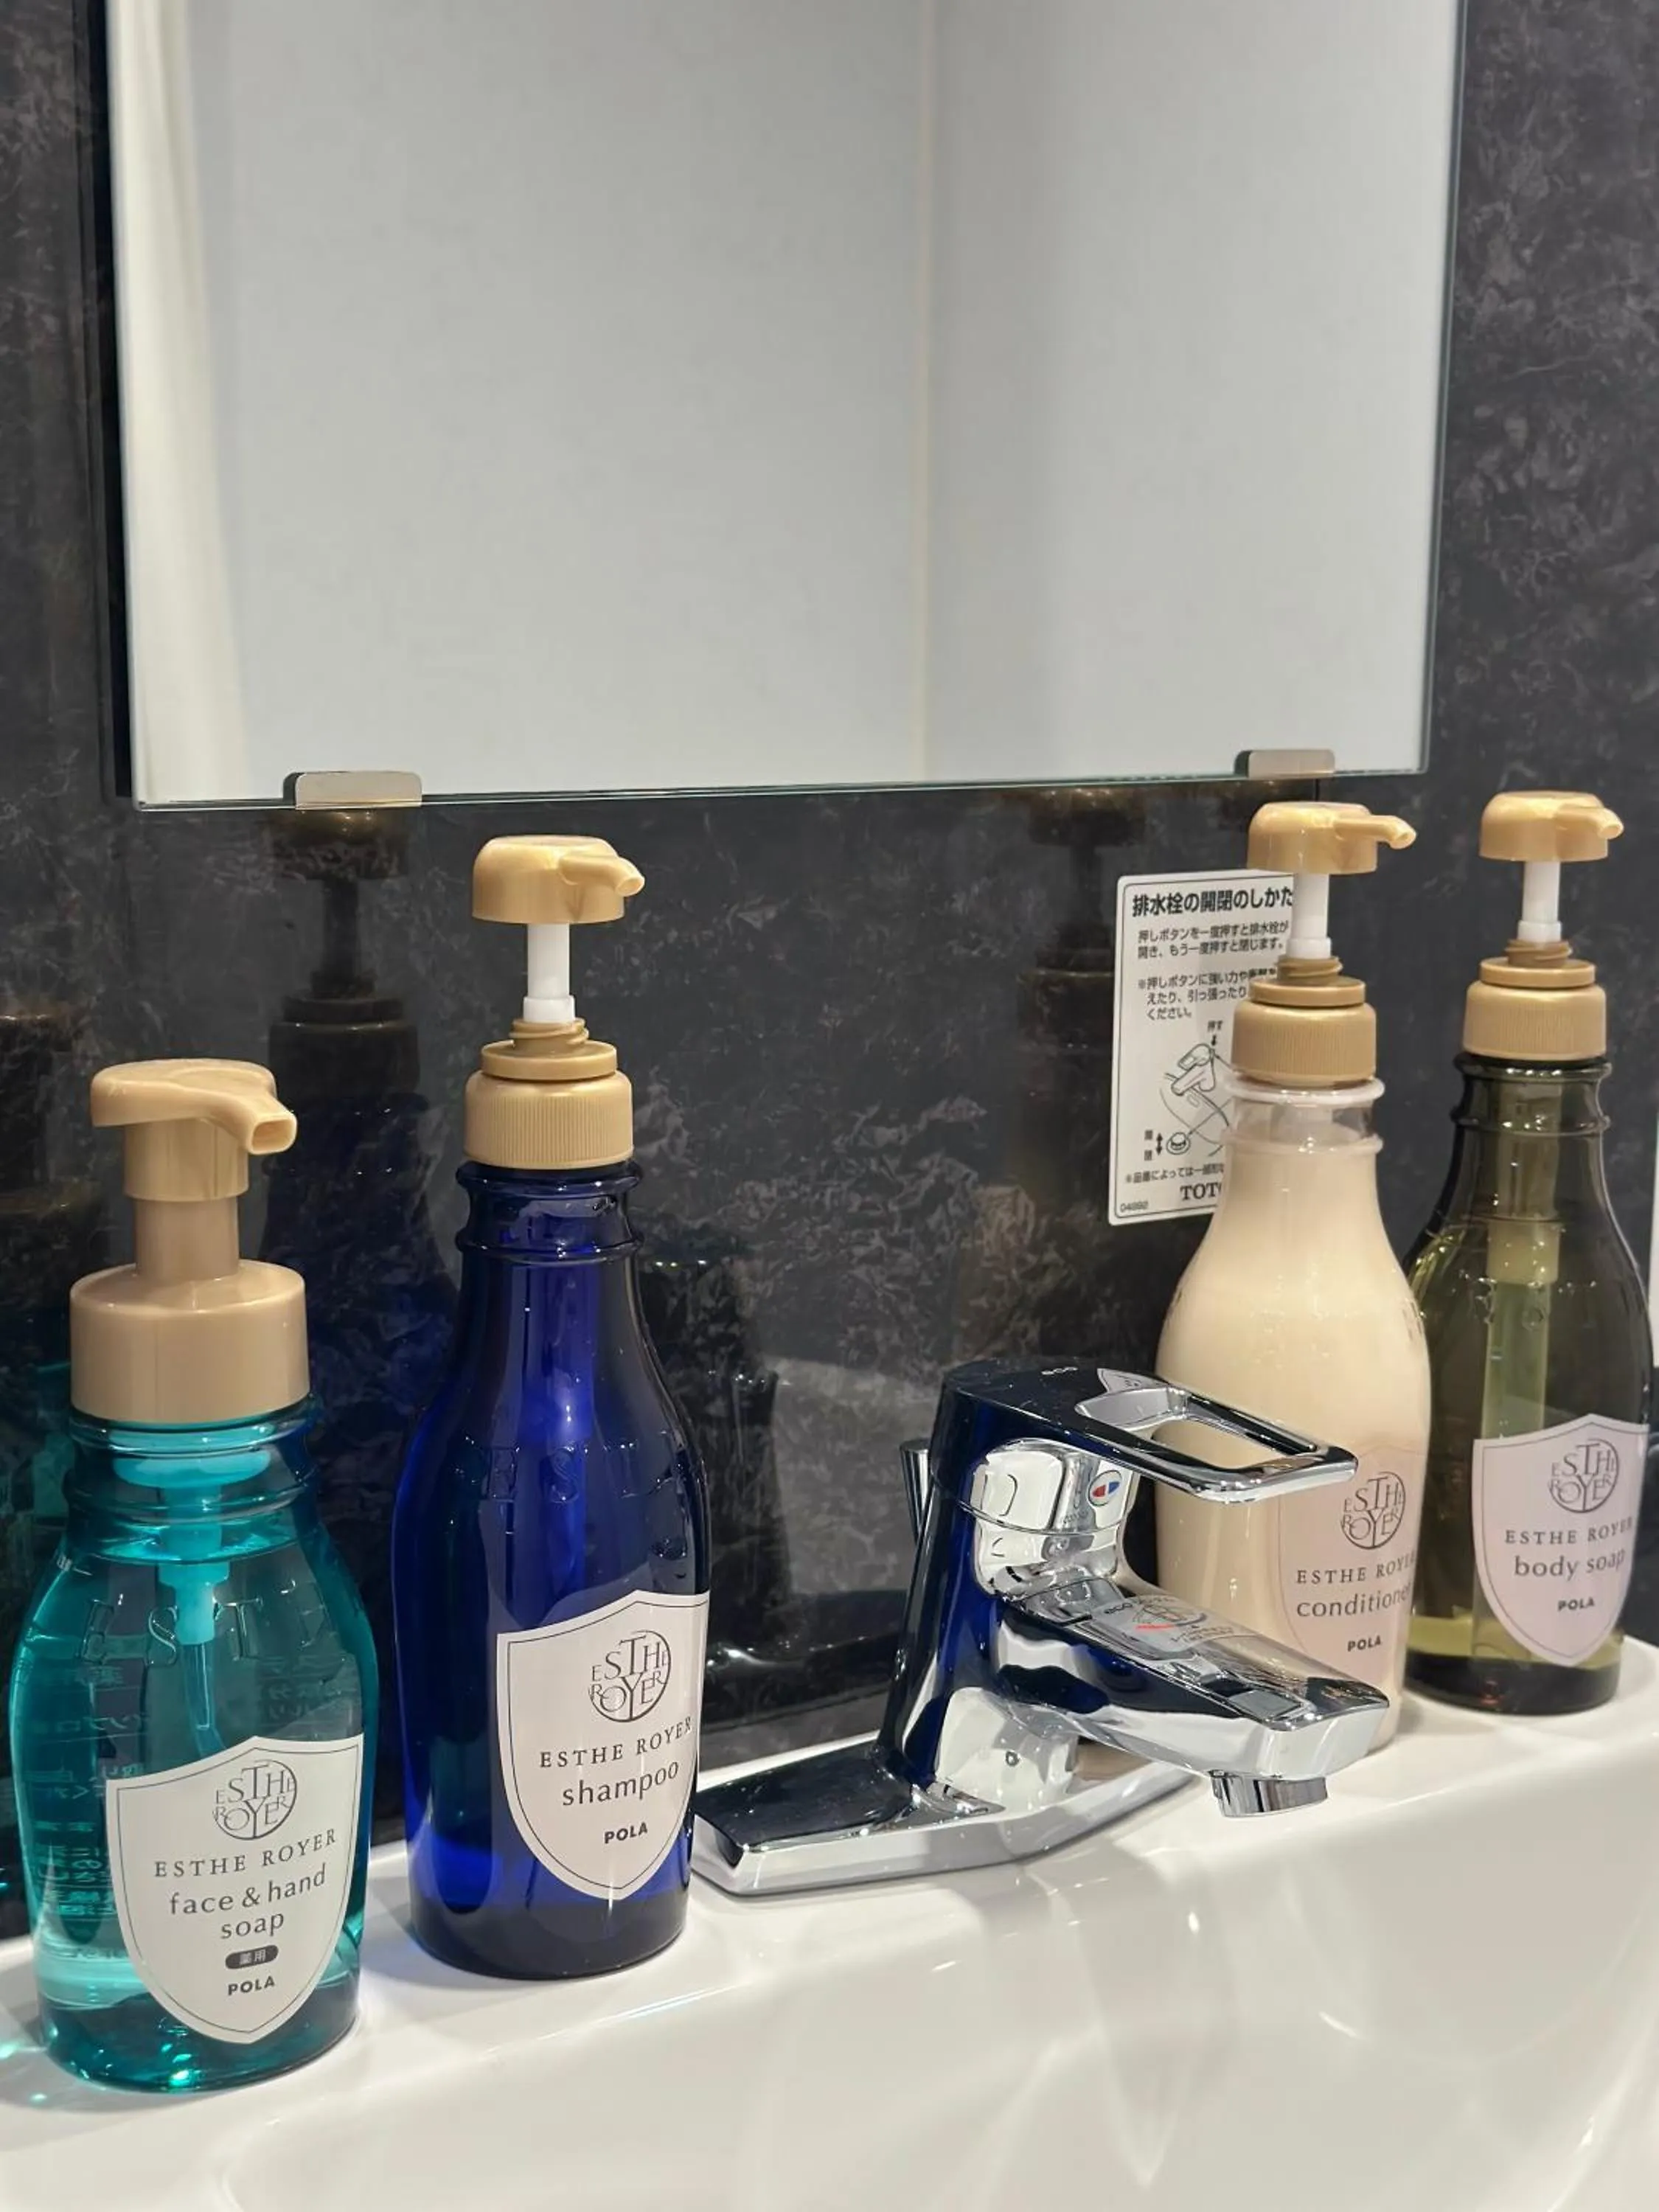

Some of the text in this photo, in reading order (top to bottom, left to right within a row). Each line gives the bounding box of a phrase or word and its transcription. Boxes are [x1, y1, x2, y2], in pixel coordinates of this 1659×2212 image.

[1133, 886, 1293, 917] 排水栓の開閉のしかた
[1505, 1530, 1577, 1545] ESTHE
[1297, 1567, 1366, 1585] ESTHE
[1515, 1549, 1625, 1582] body soap
[1557, 1597, 1595, 1612] POLA
[1347, 1635, 1382, 1652] POLA
[540, 1716, 692, 1768] ESTHE ROYER
[563, 1761, 679, 1806] shampoo
[604, 1821, 648, 1844] POLA
[155, 1828, 336, 1878] ESTHE ROYER
[170, 1863, 327, 1916] face & hand
[221, 1913, 285, 1939] soap
[228, 1975, 275, 1996] POLA
